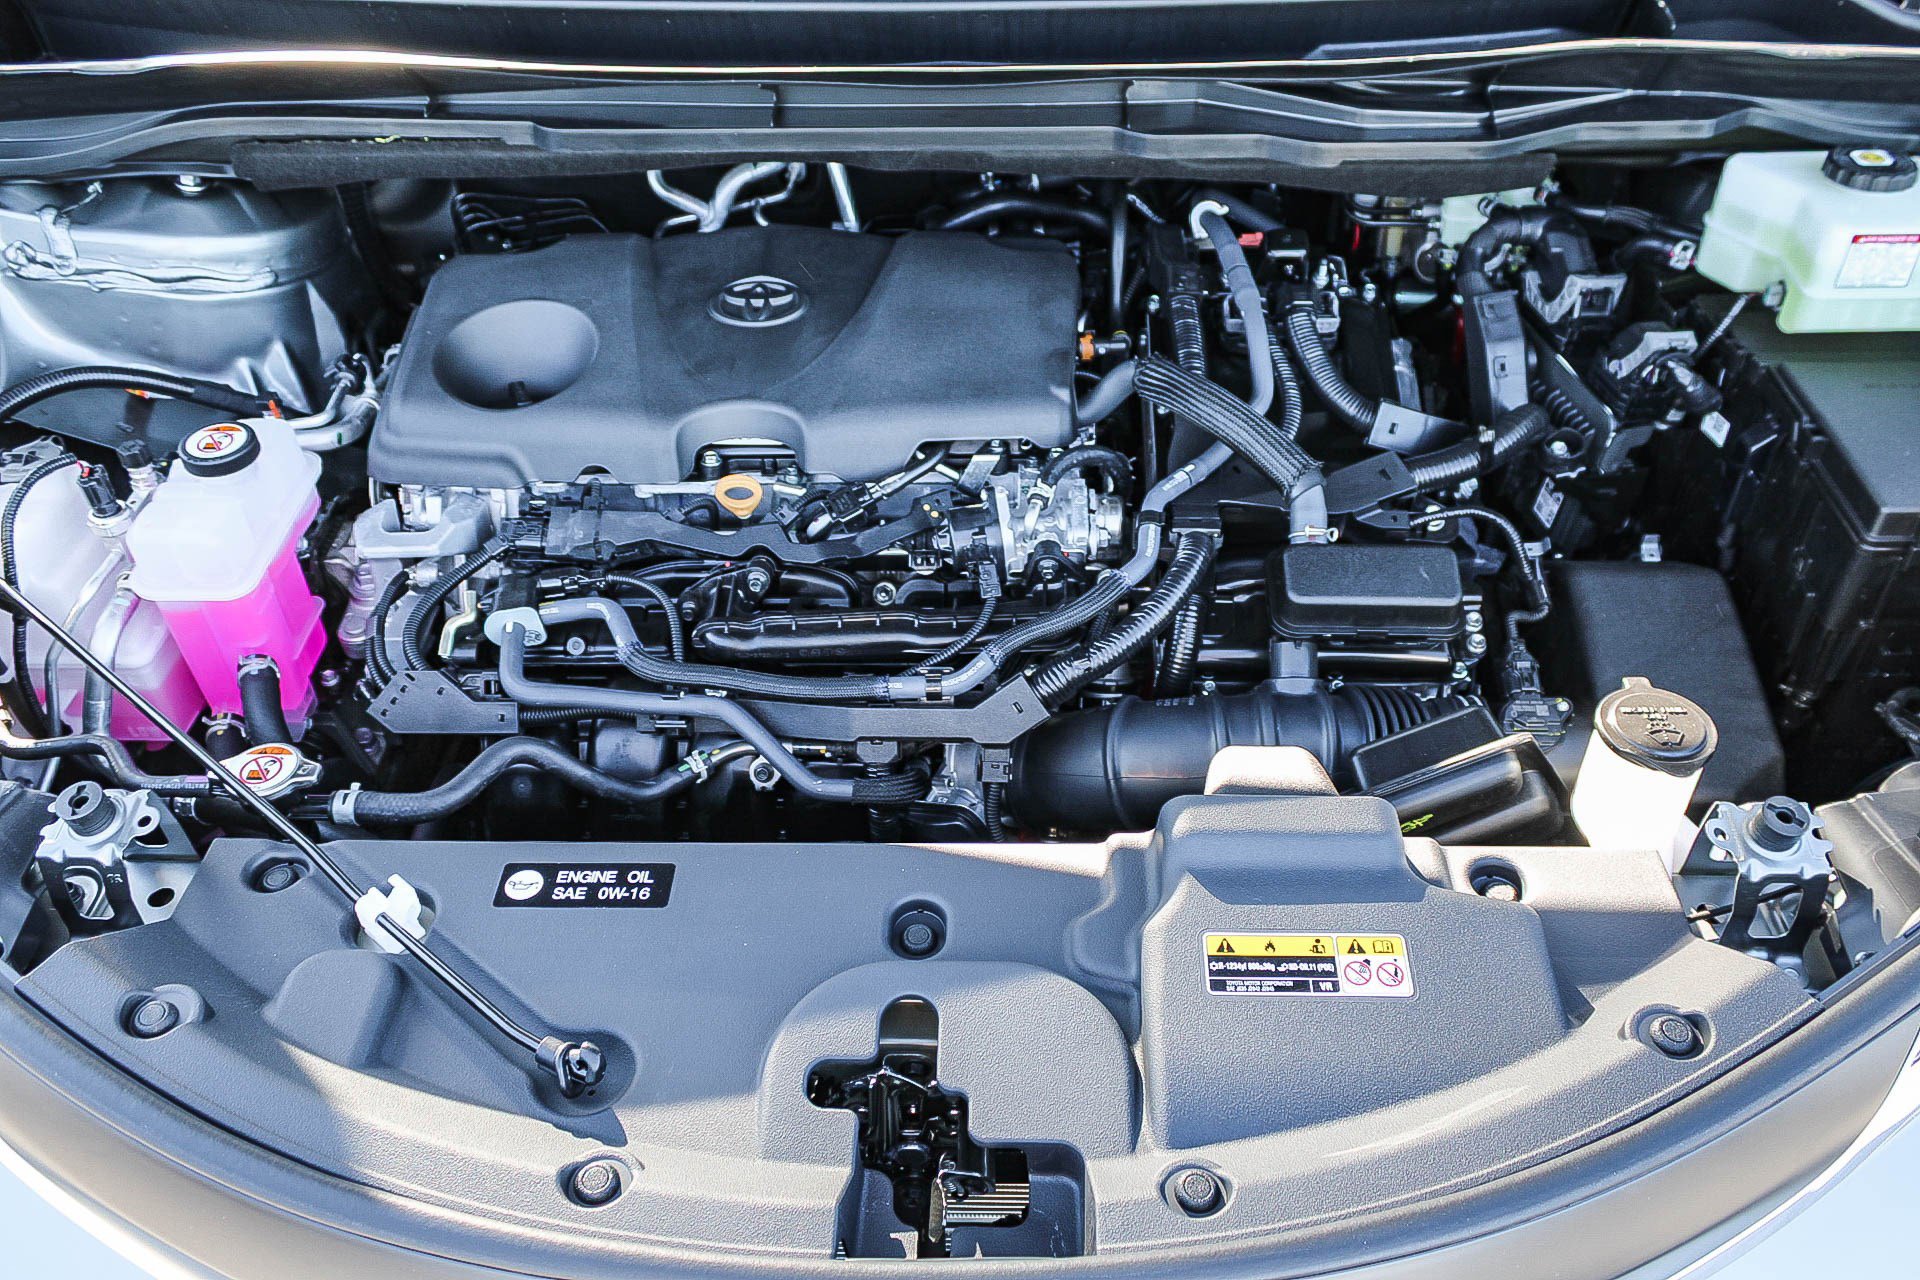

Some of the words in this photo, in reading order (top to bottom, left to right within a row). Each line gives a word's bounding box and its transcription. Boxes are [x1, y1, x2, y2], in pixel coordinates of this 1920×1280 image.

[555, 870, 618, 884] ENGINE
[626, 870, 654, 884] OIL
[552, 887, 588, 900] SAE
[597, 887, 651, 900] 0W-16
[1319, 982, 1333, 991] VR
